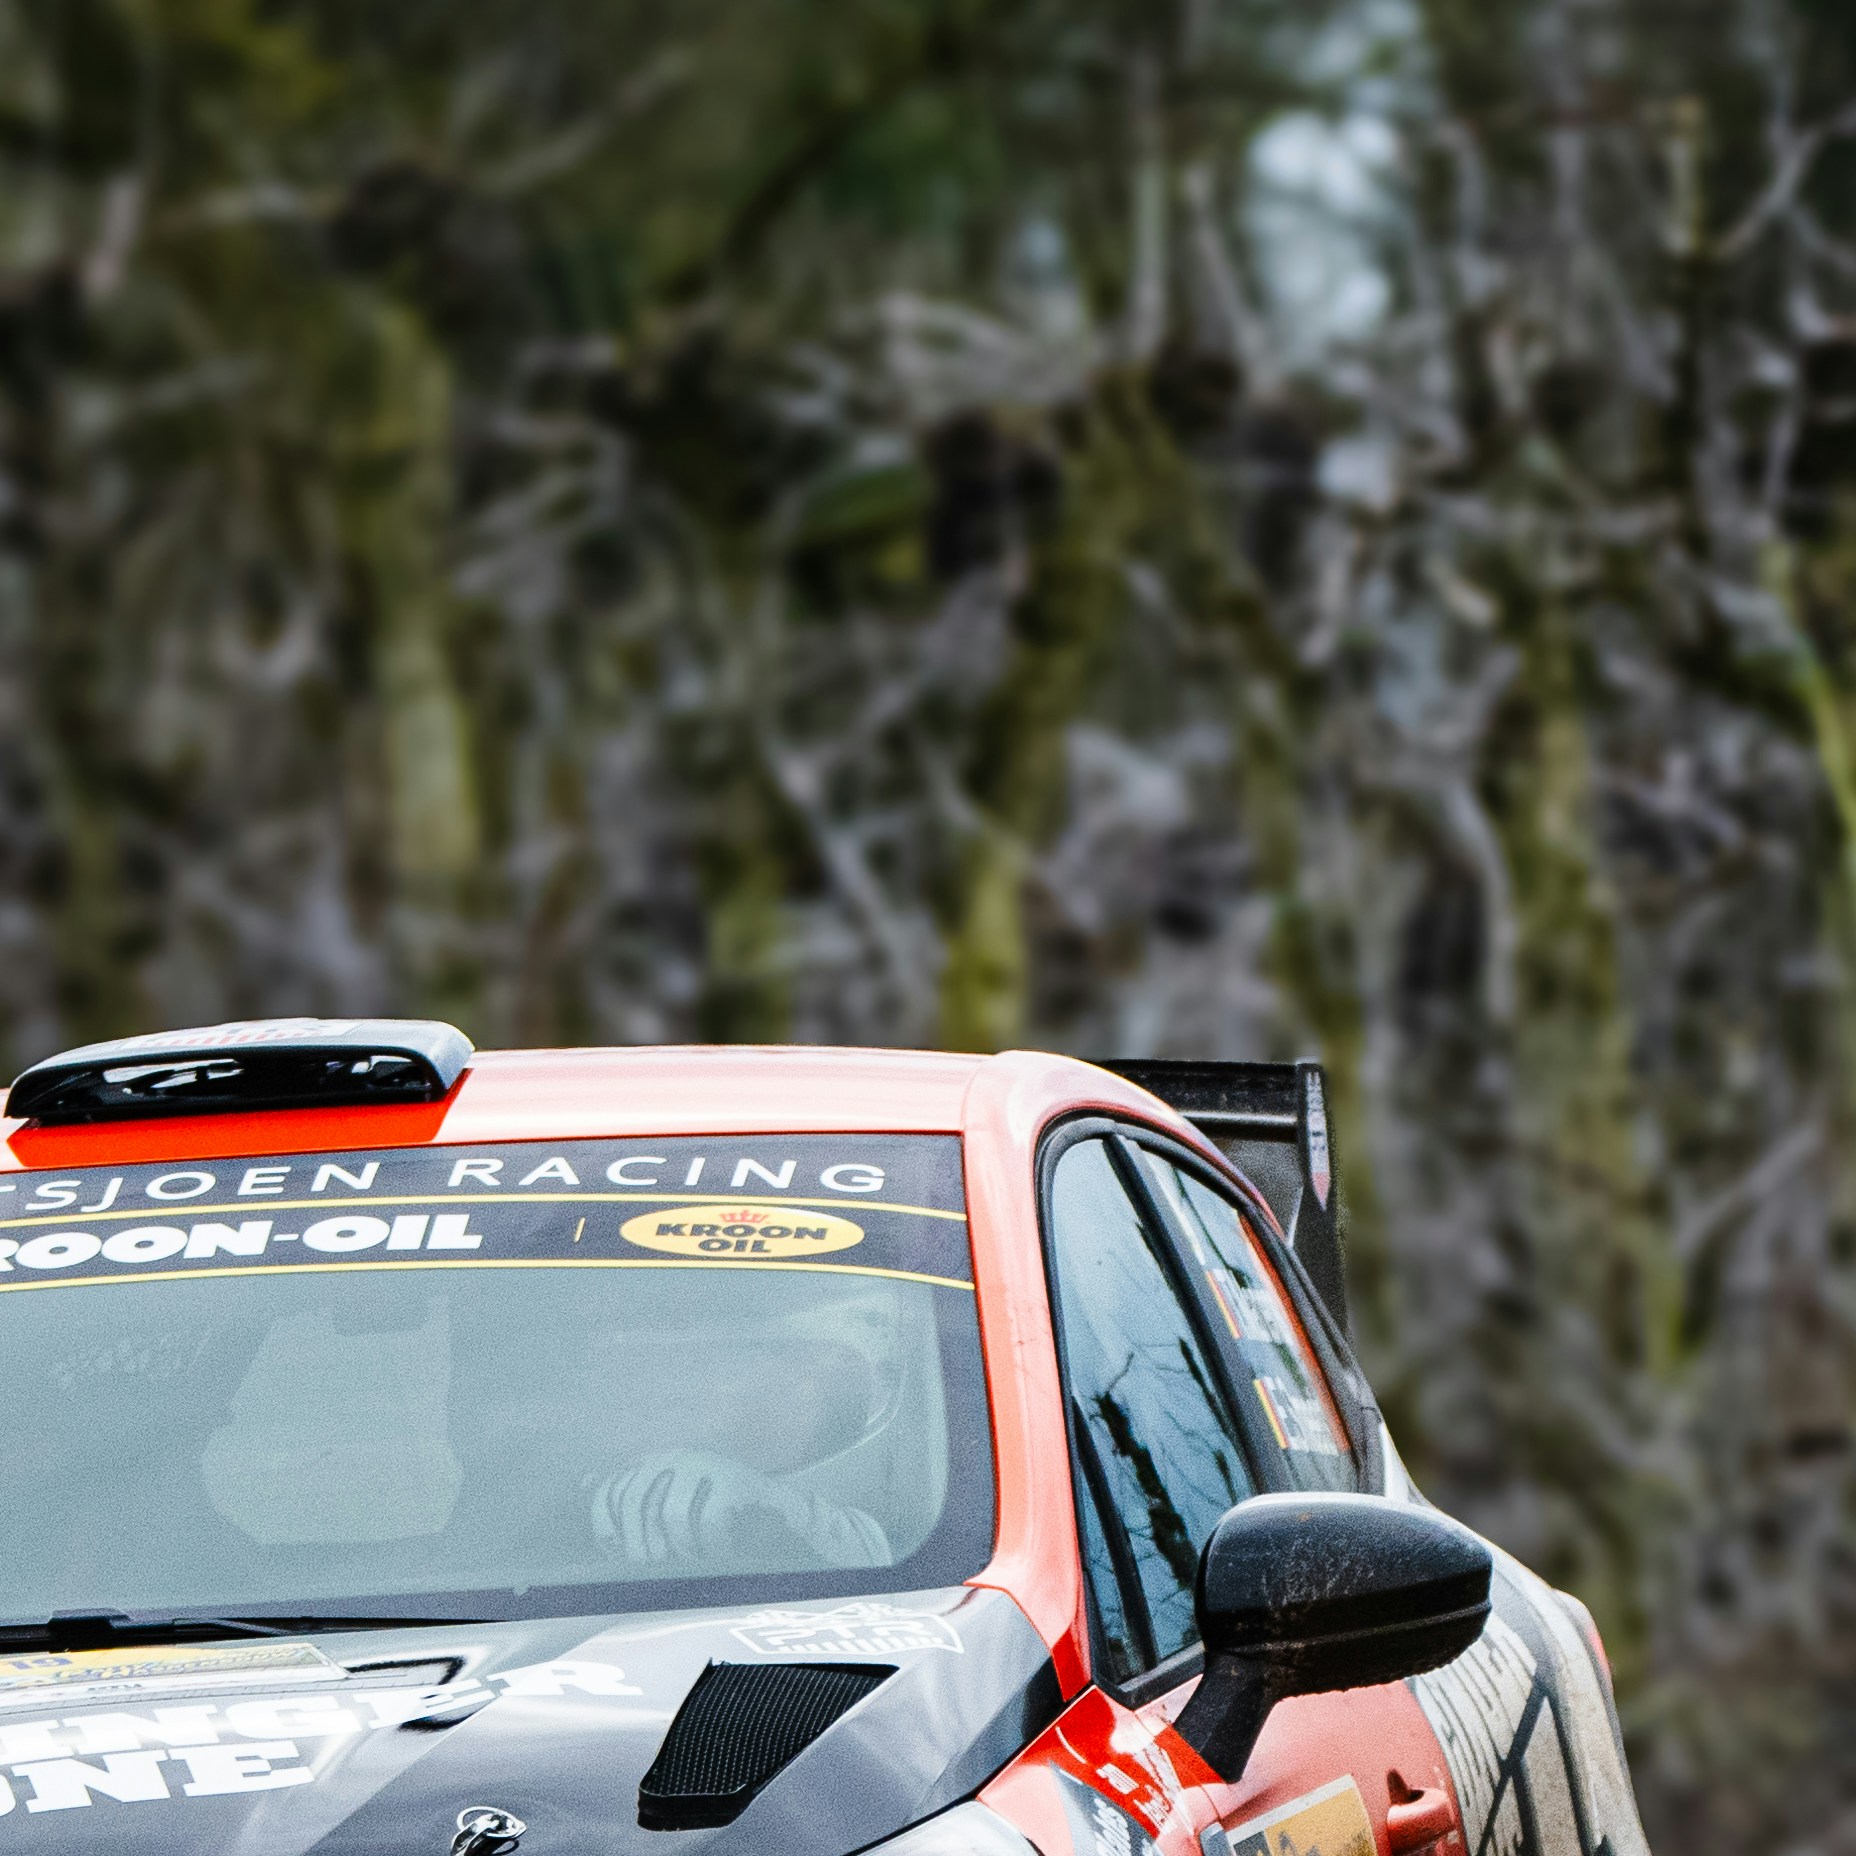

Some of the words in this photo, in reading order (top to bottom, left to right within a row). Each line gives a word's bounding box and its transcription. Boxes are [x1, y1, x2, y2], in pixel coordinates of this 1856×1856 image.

[446, 1155, 887, 1193] RACING
[654, 1223, 829, 1241] KROON
[697, 1236, 773, 1254] OIL
